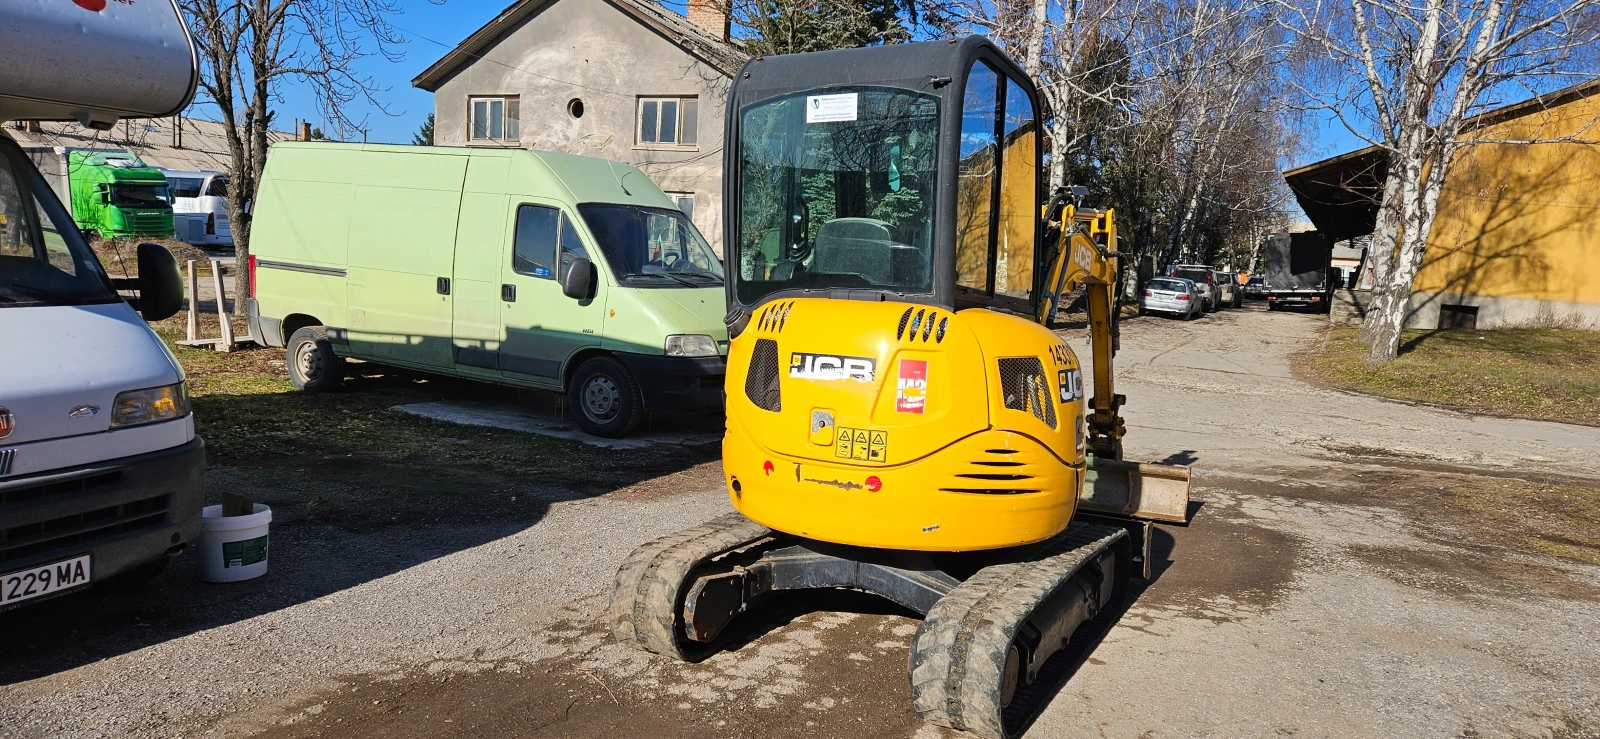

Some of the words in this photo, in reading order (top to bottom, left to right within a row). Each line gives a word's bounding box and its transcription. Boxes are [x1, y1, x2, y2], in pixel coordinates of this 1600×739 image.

[1075, 241, 1092, 272] JCB
[790, 355, 874, 383] JCB
[1060, 370, 1084, 400] JC
[56, 560, 86, 588] MA
